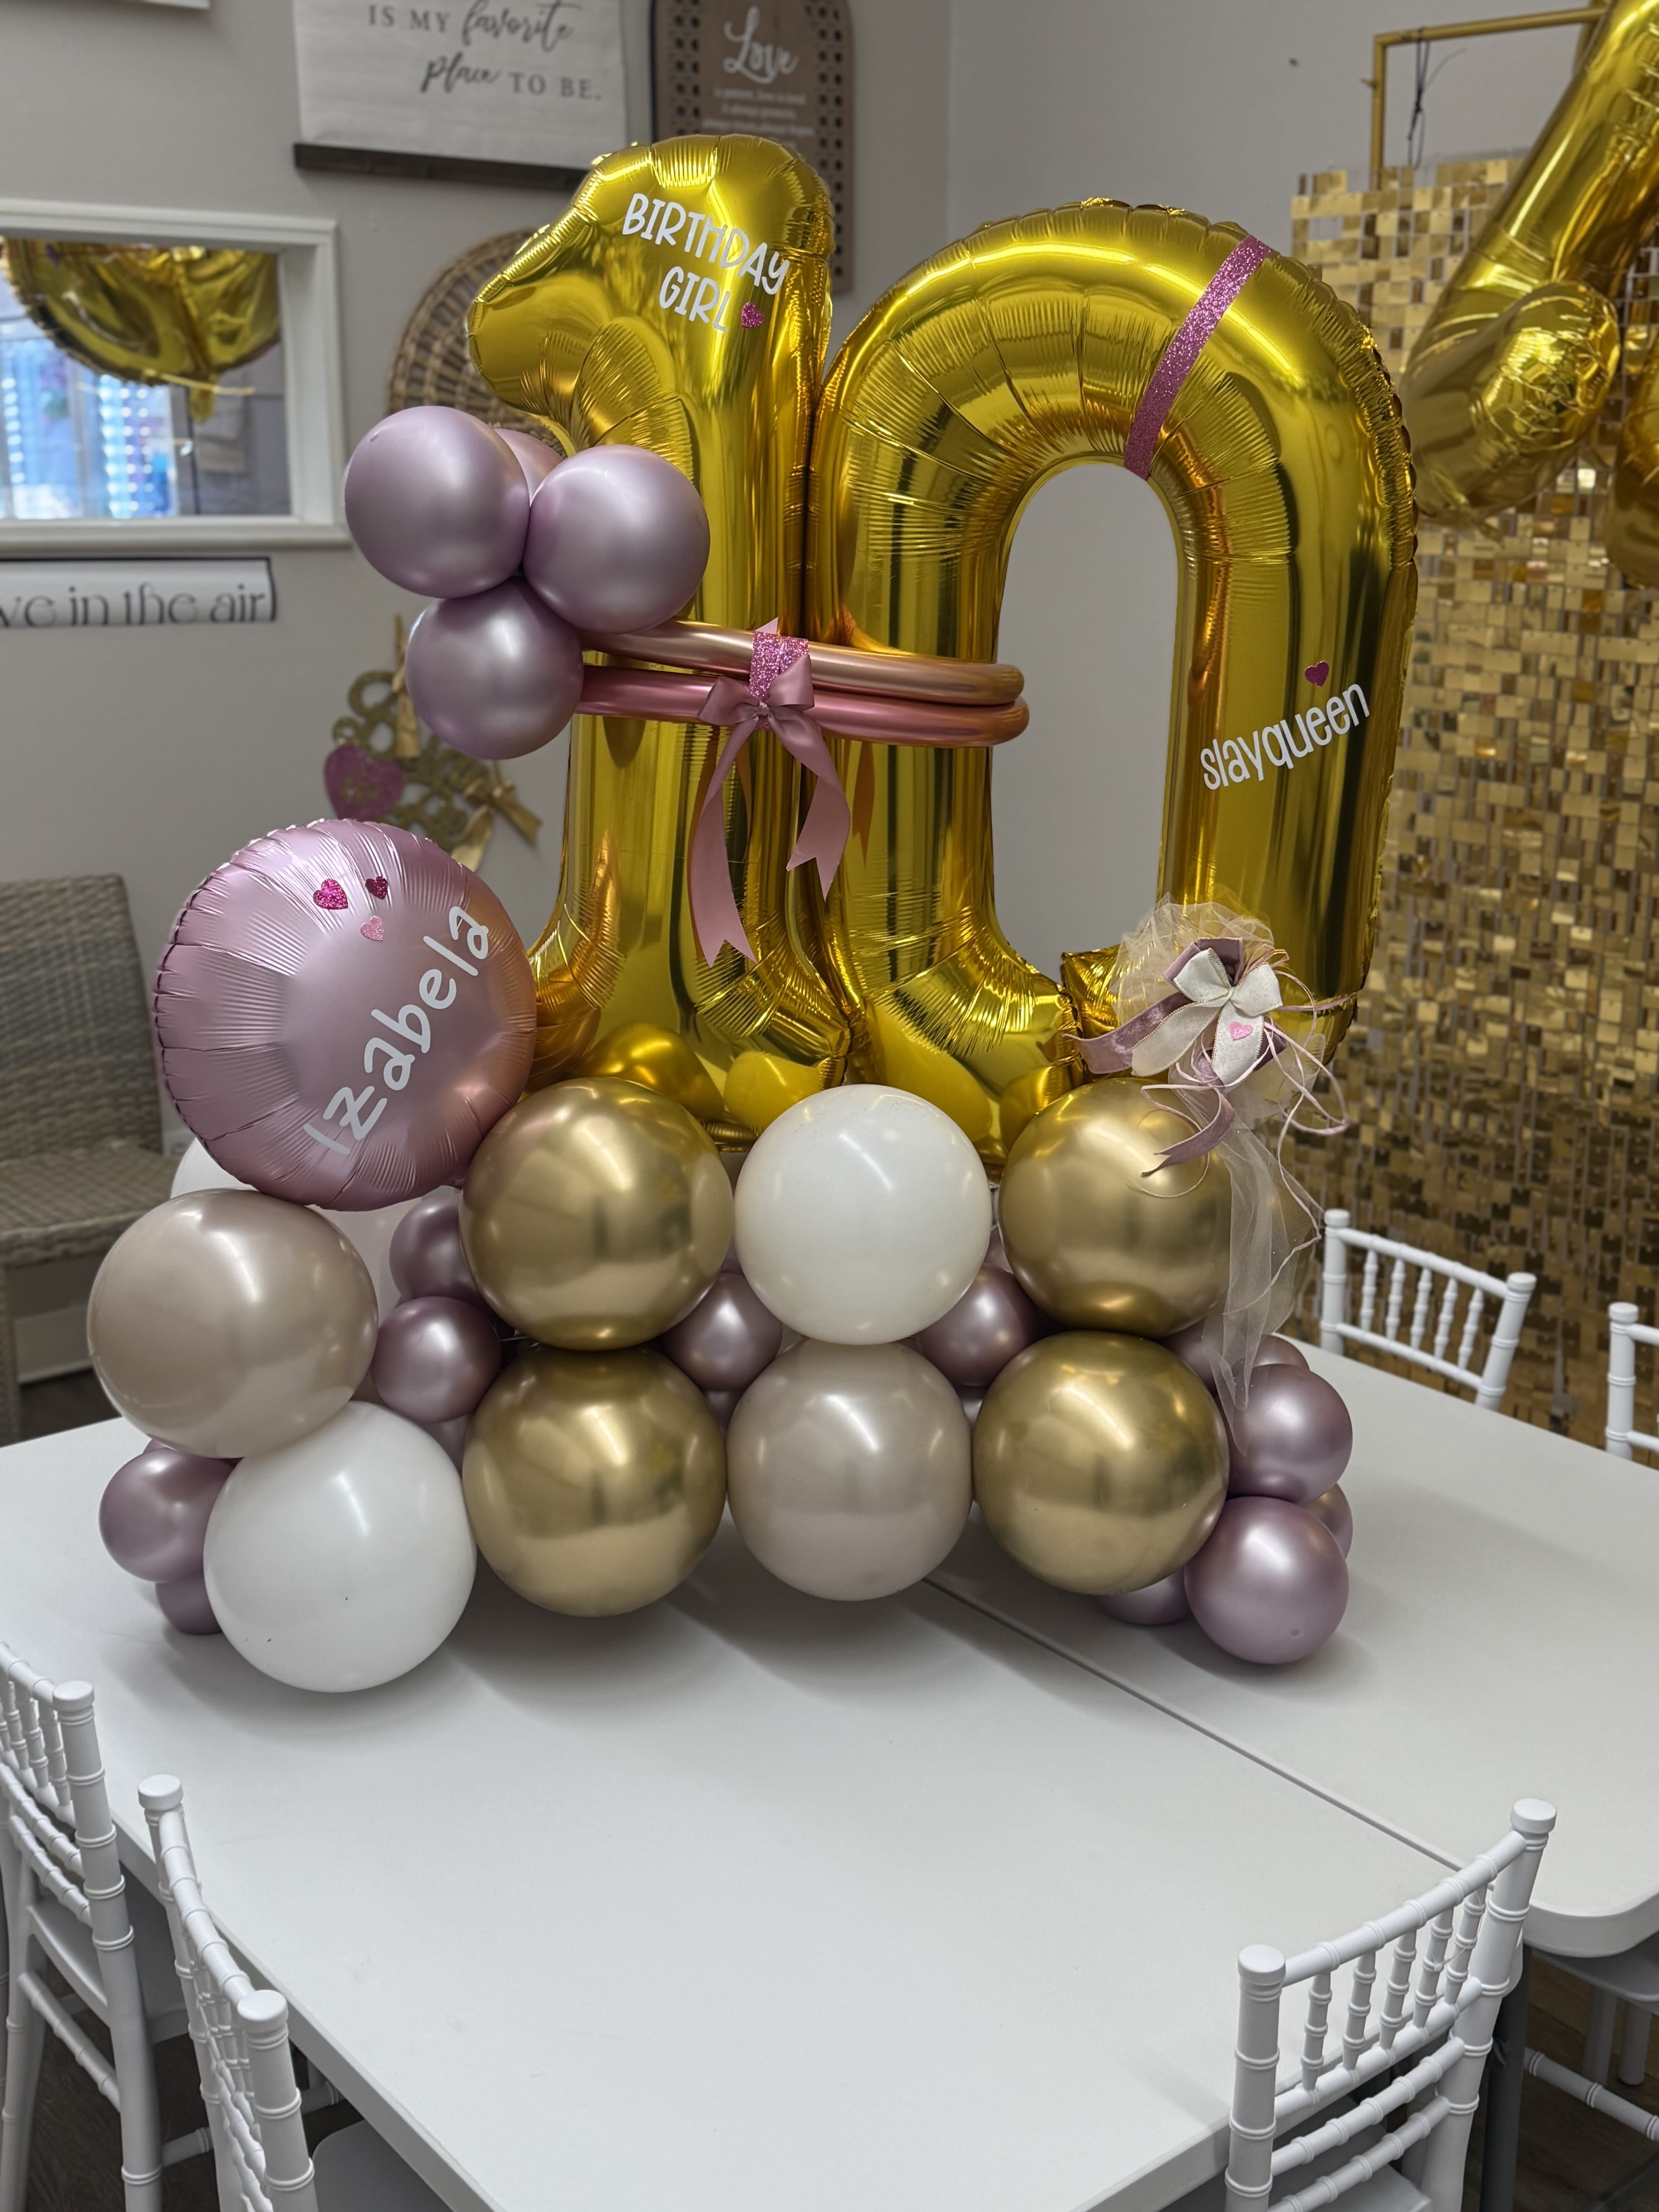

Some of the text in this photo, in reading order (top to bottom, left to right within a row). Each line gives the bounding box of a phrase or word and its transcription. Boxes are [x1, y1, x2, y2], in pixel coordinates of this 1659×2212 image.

[368, 0, 582, 52] IS MY favorite
[722, 5, 800, 84] Love
[420, 51, 603, 100] place TO BE.
[622, 193, 790, 295] BIRTHDAY
[659, 266, 731, 332] GIRL
[68, 586, 110, 627] in
[124, 581, 197, 625] the
[210, 583, 266, 624] air
[1200, 684, 1370, 790] slayqueen
[303, 906, 489, 1155] Izabela
